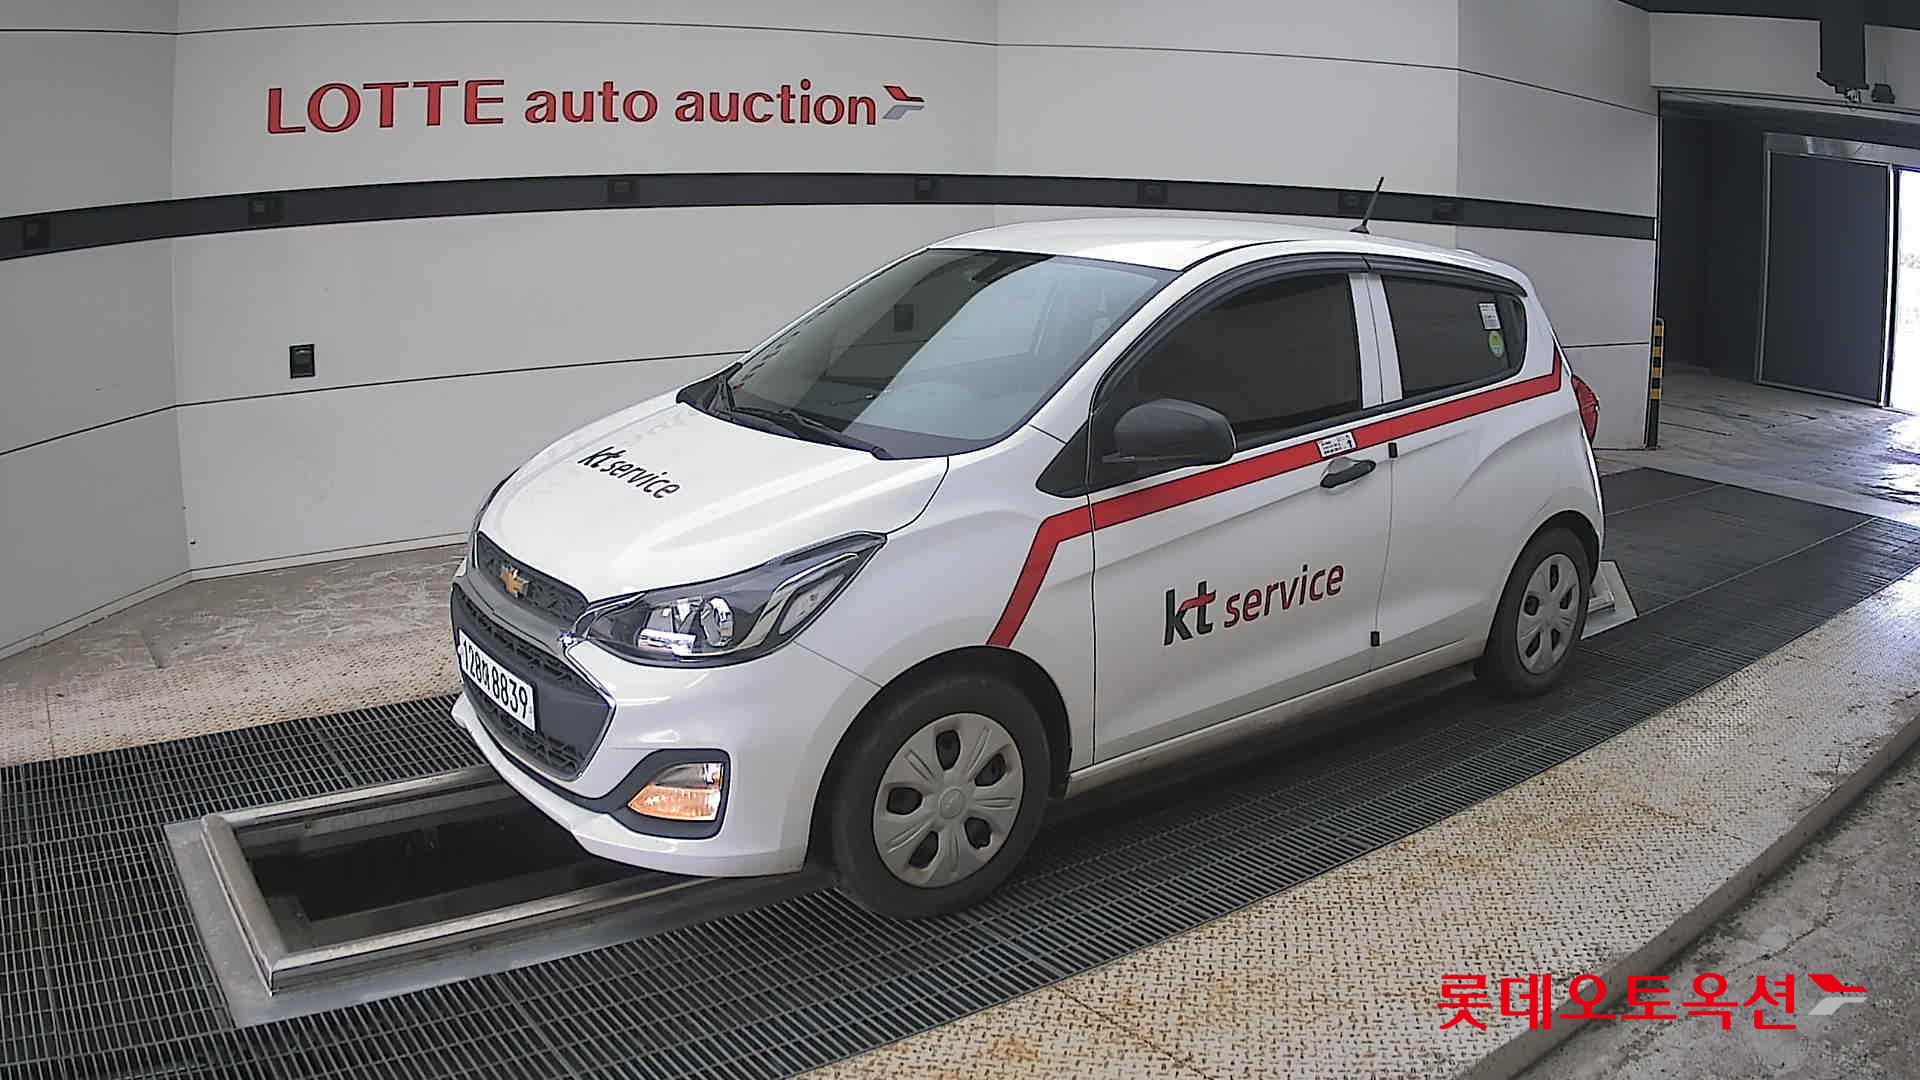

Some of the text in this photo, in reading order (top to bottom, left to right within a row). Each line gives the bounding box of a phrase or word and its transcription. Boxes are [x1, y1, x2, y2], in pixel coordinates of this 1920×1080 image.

[267, 79, 877, 134] LOTTE auto auction
[577, 446, 680, 498] kt service
[1164, 564, 1344, 646] kt service
[491, 666, 528, 719] 8839
